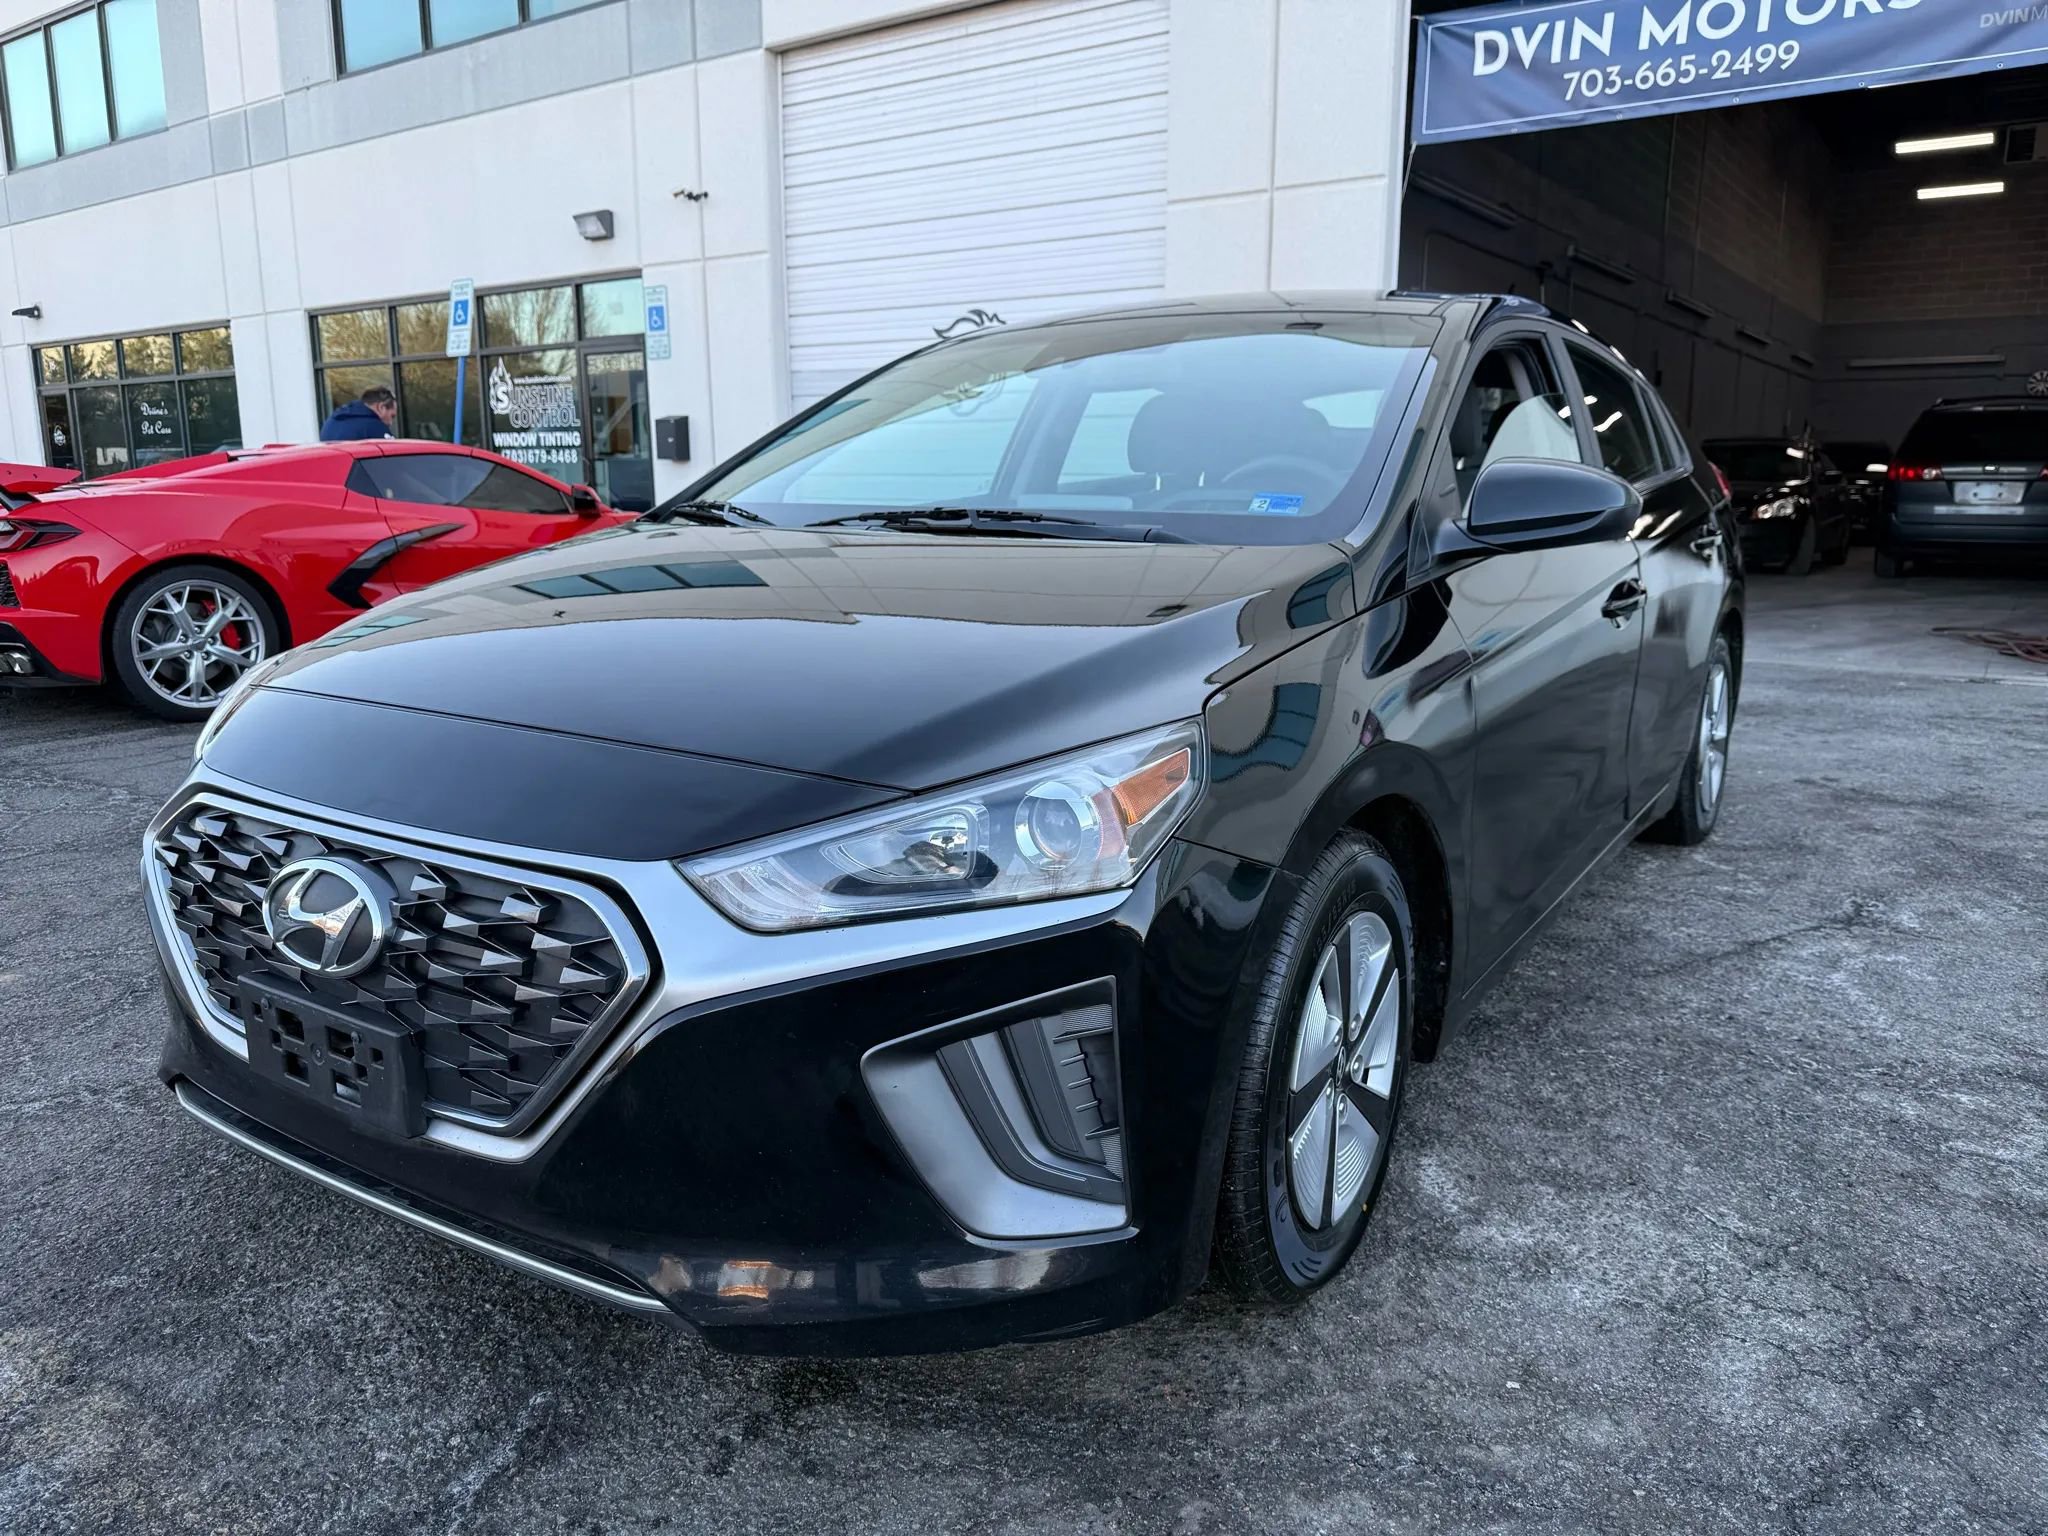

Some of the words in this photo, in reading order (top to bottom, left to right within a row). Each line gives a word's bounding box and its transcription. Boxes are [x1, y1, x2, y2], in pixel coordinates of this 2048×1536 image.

[1473, 12, 1615, 76] DVIN
[1638, 0, 1923, 51] MOTO
[1563, 39, 1800, 100] 703-665-2499
[509, 405, 581, 429] CONTROL
[493, 431, 537, 447] WINDOW
[538, 431, 581, 446] TINTING
